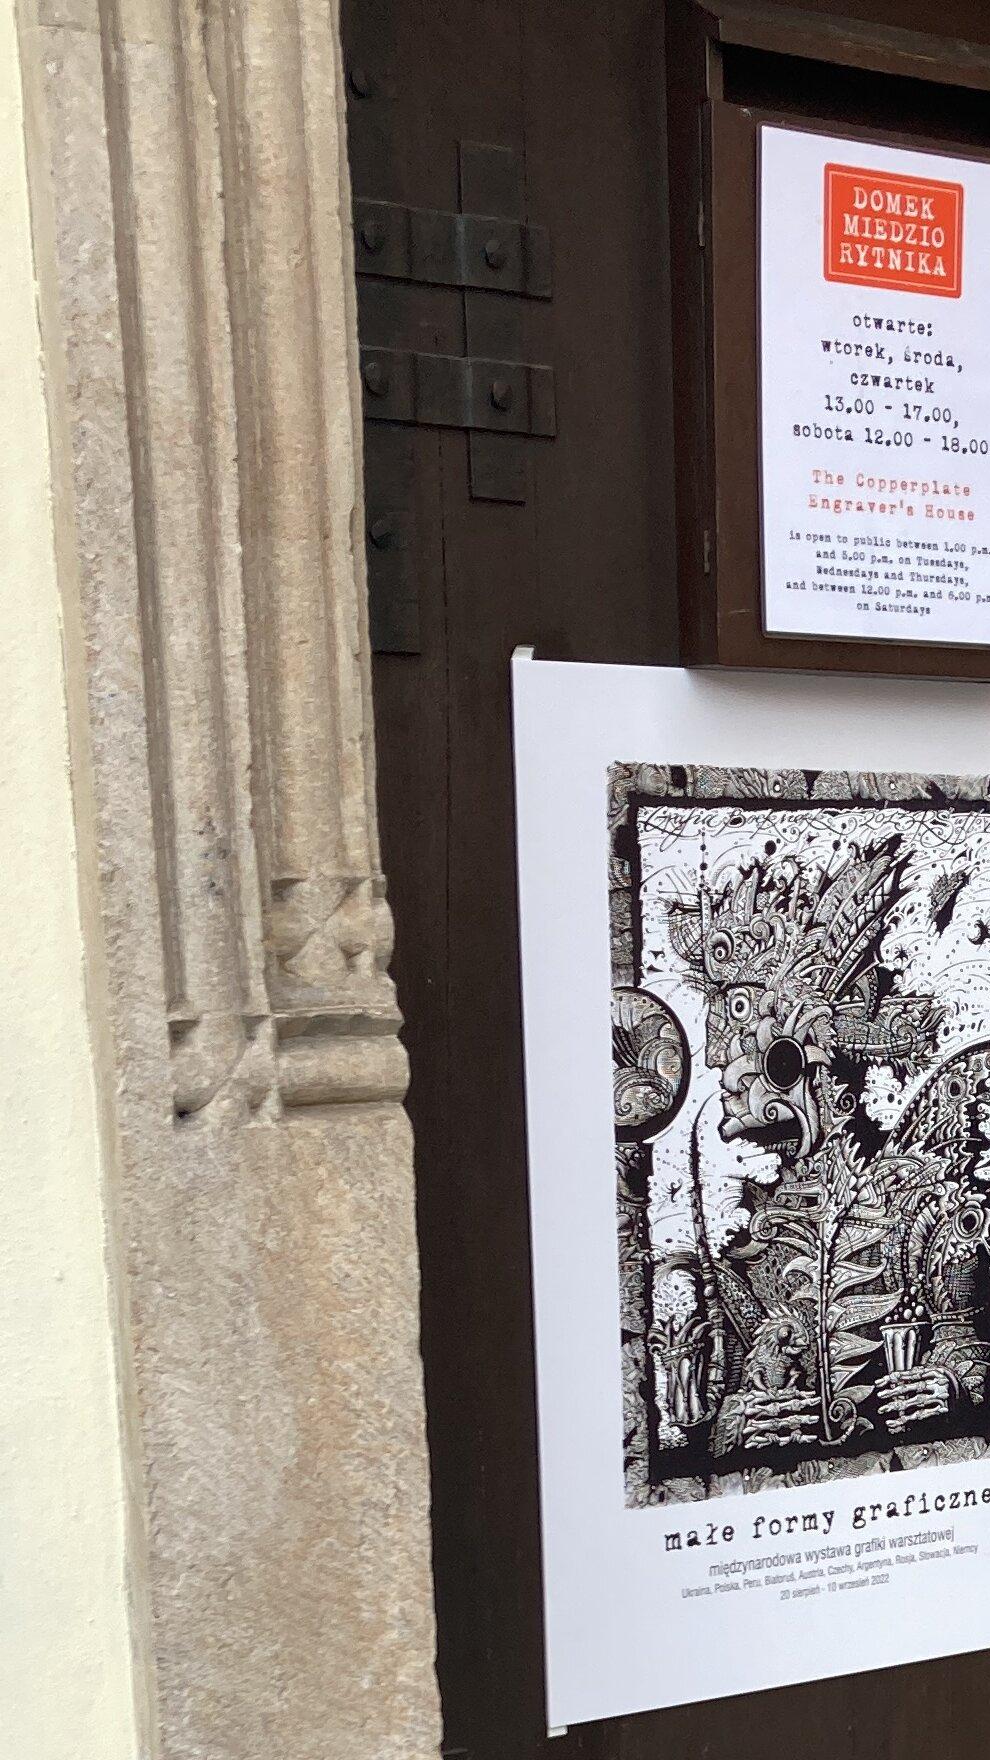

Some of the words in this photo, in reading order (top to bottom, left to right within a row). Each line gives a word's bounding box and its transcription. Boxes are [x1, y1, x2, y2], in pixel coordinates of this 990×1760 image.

[853, 186, 935, 220] DOMEK
[843, 213, 945, 248] MIEDZIO
[840, 242, 947, 277] RYTNIKA
[853, 313, 933, 337] otwarte:
[821, 338, 893, 365] wtorek,
[904, 346, 963, 373] środa,
[851, 371, 935, 394] czwartek
[825, 394, 874, 415] 13.00
[904, 403, 959, 429] 17.00,
[793, 422, 853, 441] sobota
[865, 427, 913, 447] 12.00
[941, 435, 988, 455] 18.00
[812, 469, 844, 485] The
[856, 472, 970, 497] Copperplate
[809, 493, 914, 516] Engraver's
[926, 504, 974, 521] House
[789, 530, 801, 540] is
[806, 533, 831, 544] open
[837, 534, 848, 543] to
[854, 536, 891, 547] public
[896, 538, 938, 551] between
[944, 541, 966, 553] 1.00
[816, 549, 836, 560] and
[842, 550, 866, 561] 5.00
[870, 554, 893, 565] p.m.
[898, 556, 911, 565] on
[916, 555, 969, 572] Tuesdays,
[785, 580, 806, 590] and
[811, 581, 856, 594] between
[861, 584, 890, 596] 12.00
[895, 589, 918, 599] p.m.
[923, 589, 942, 600] and
[948, 590, 971, 601] 6.00
[816, 565, 879, 581] Wednesdays
[884, 570, 904, 581] and
[910, 571, 969, 588] Thursdays,
[856, 602, 870, 611] on
[875, 602, 931, 617] Saturdays
[664, 1522, 735, 1552] małe
[752, 1508, 835, 1540] formy
[708, 1551, 802, 1578] międzynarodowa
[805, 1543, 851, 1564] wystawa
[854, 1536, 886, 1558] grafiki
[889, 1526, 955, 1549] warsztatowej
